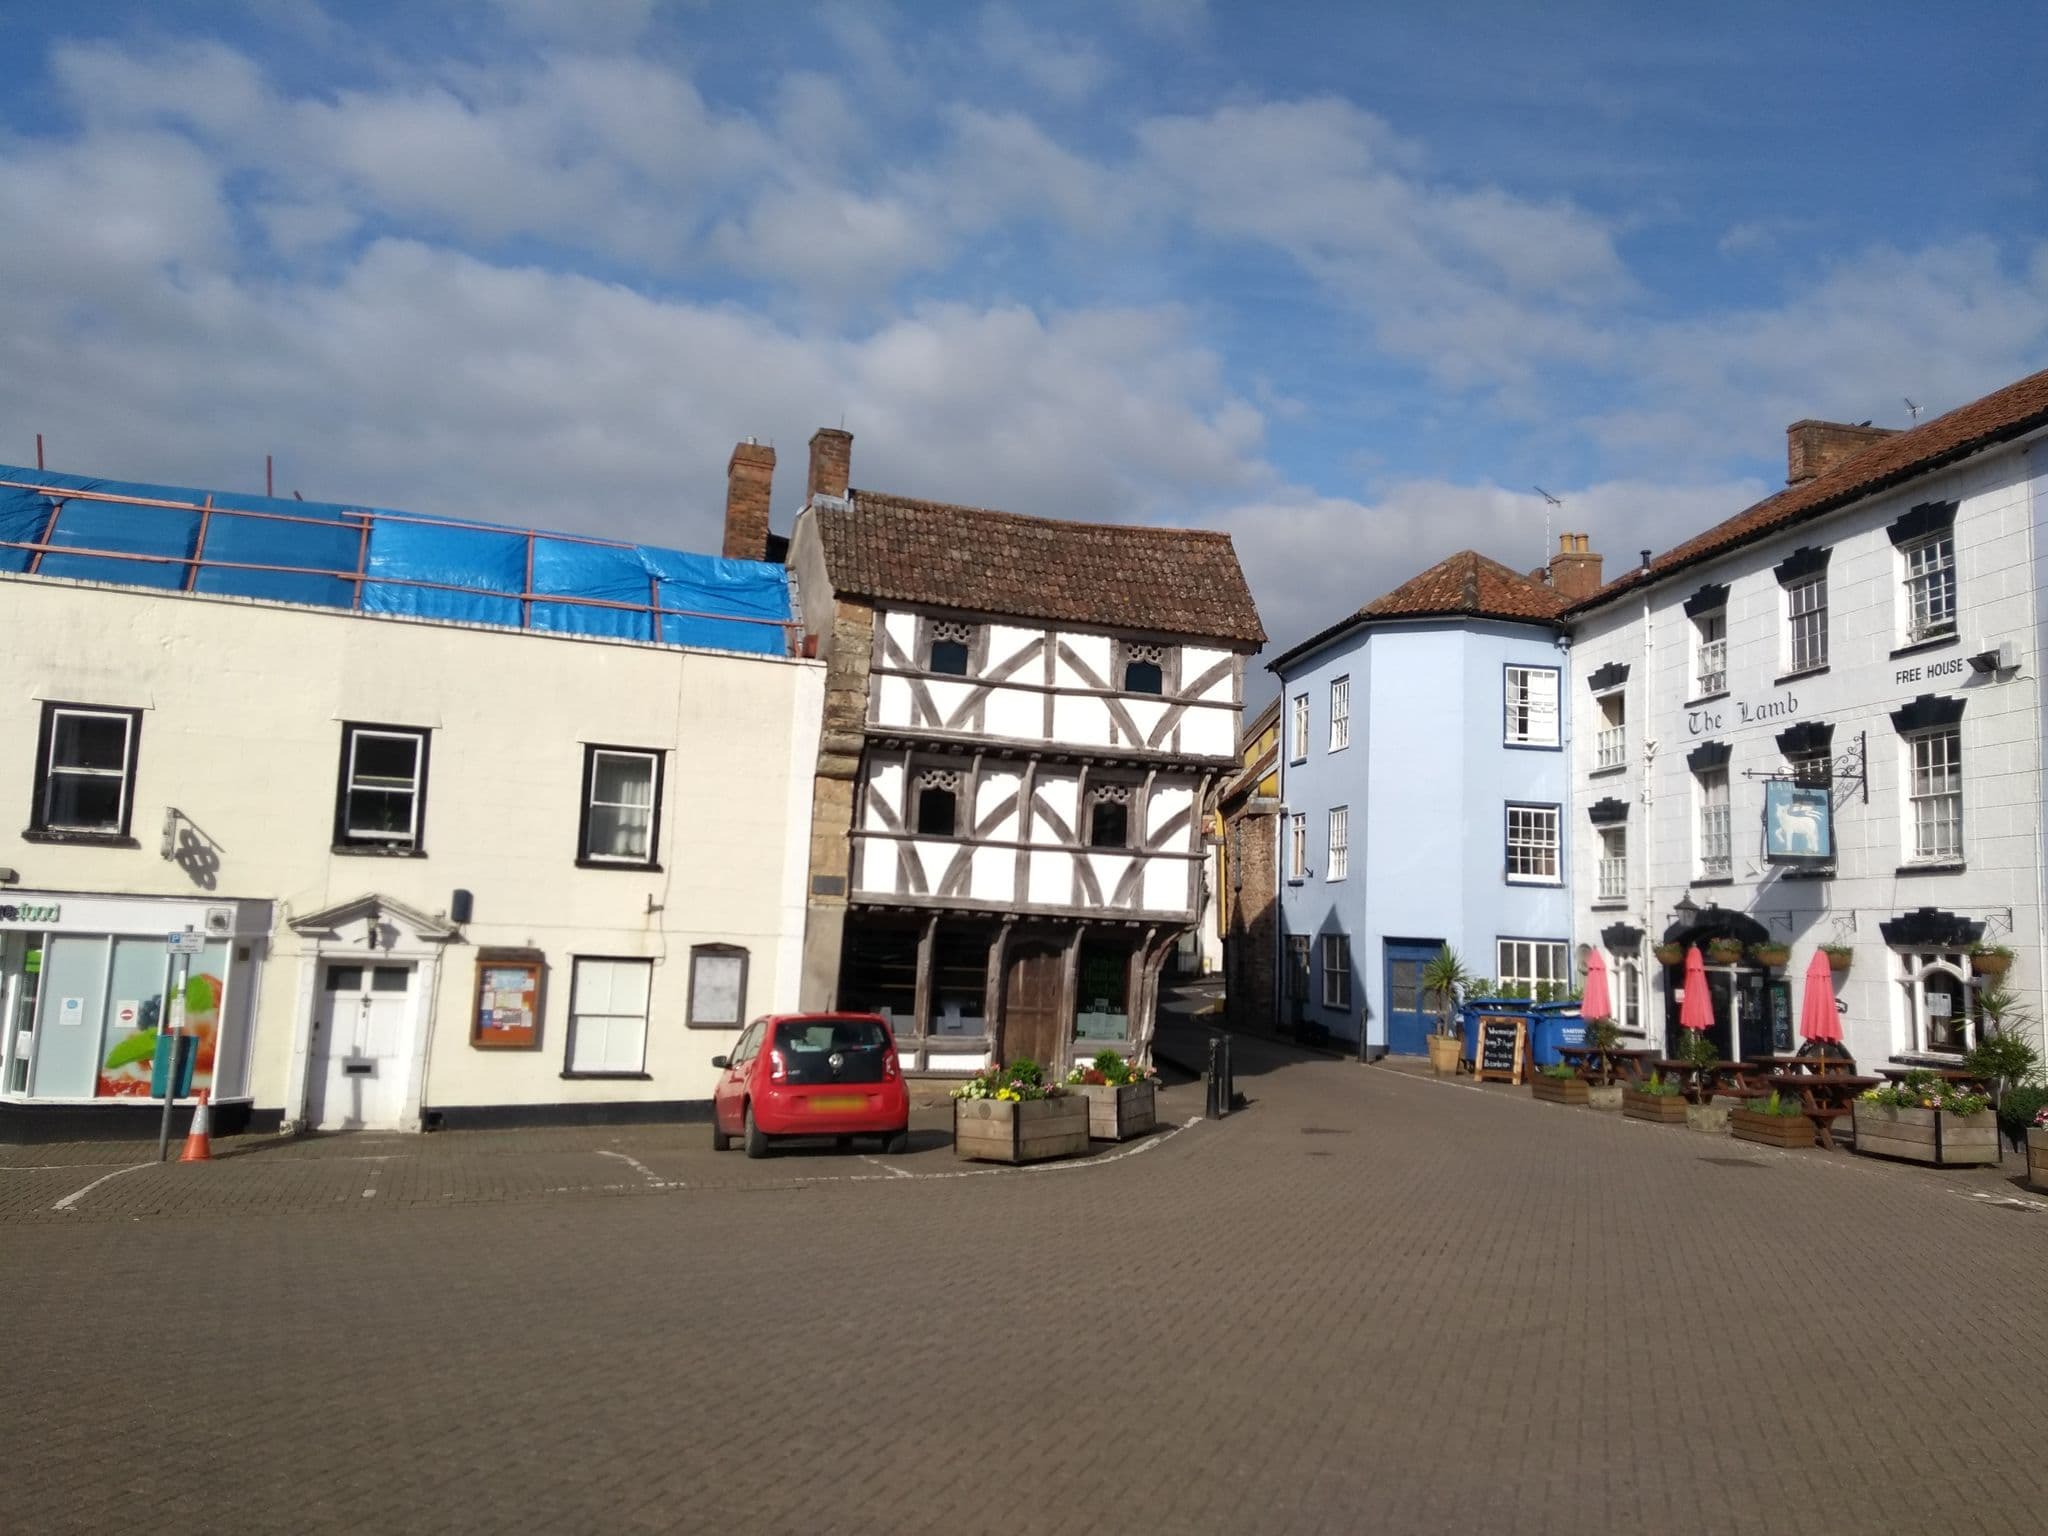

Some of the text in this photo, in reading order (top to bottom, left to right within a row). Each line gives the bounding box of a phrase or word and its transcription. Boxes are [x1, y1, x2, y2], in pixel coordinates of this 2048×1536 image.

[1895, 658, 1963, 685] FREE HOUSE
[1688, 691, 1799, 735] The Lamb
